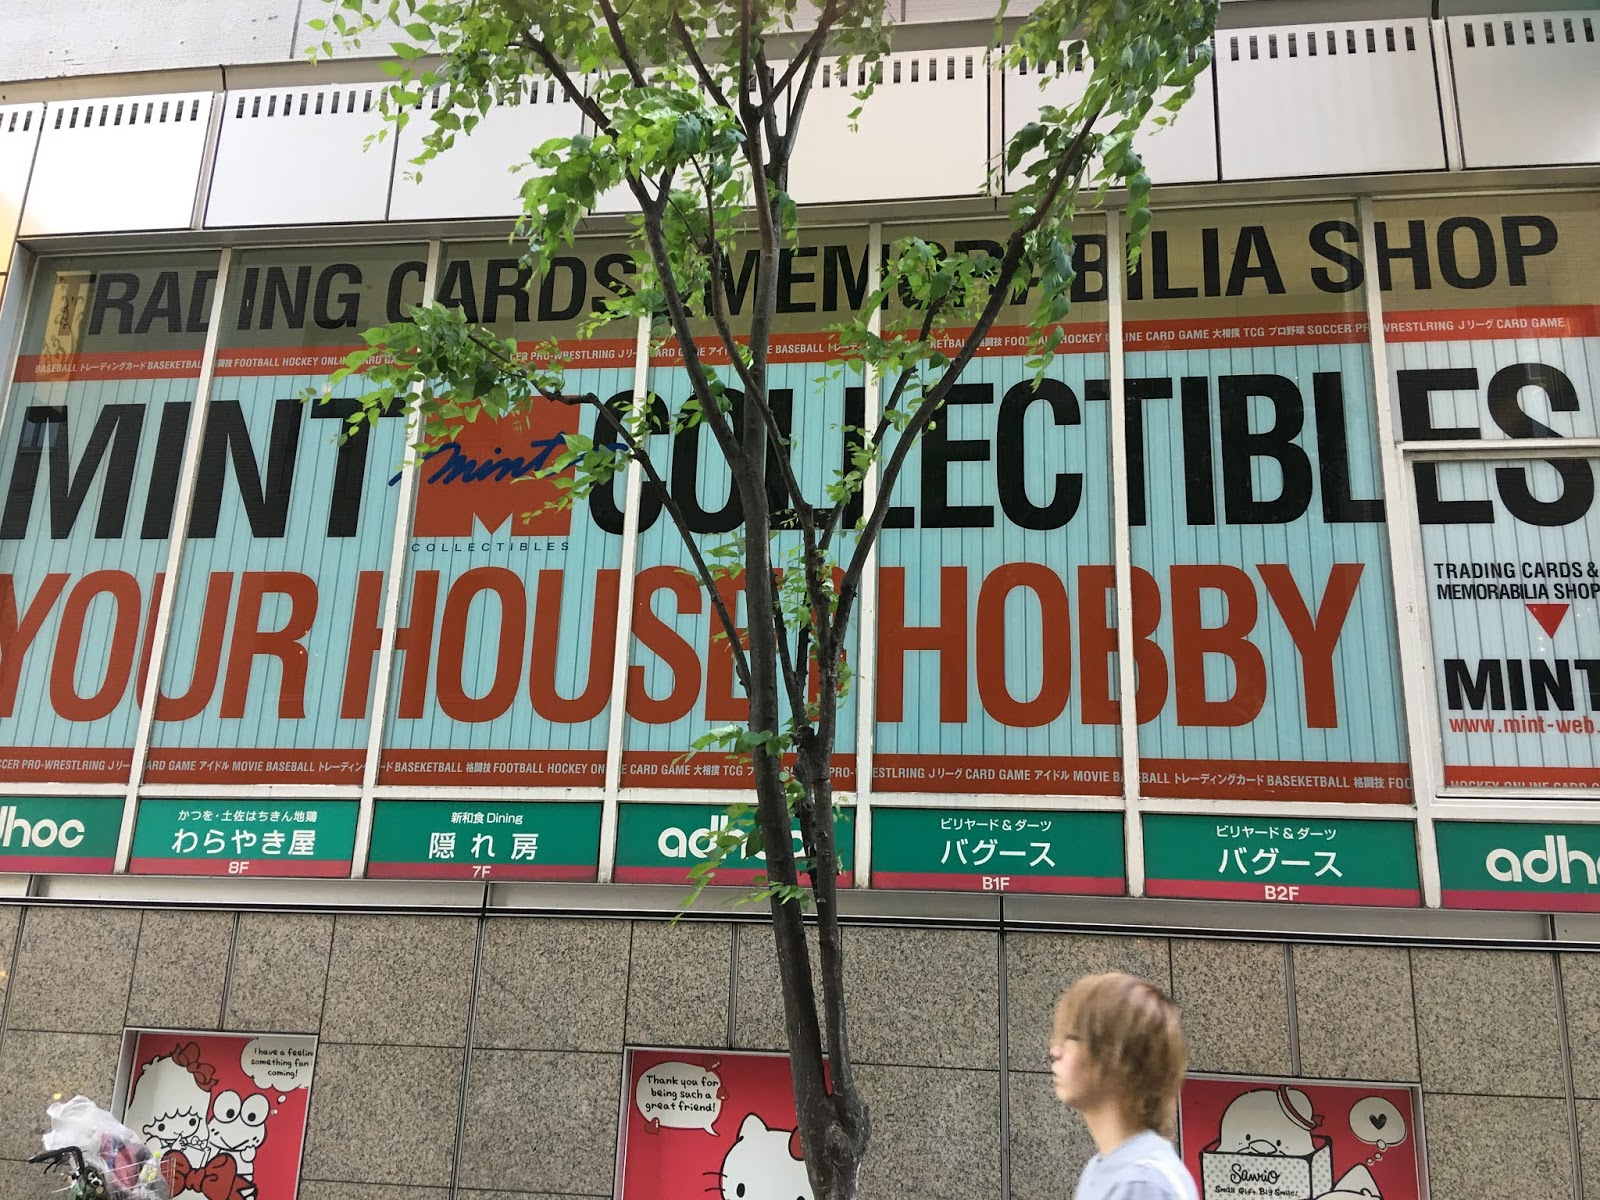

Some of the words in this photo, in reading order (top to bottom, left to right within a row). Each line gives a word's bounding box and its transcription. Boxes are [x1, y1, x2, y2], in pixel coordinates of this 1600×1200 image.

[385, 253, 638, 325] CARDS
[703, 226, 1286, 317] MEMBILIA
[1308, 215, 1558, 294] SHOP
[35, 363, 77, 373] BASEBALL
[147, 360, 203, 370] BASEKETBAL
[213, 358, 233, 368] 闘技
[234, 357, 280, 367] FOOTBALL
[283, 356, 319, 367] HOCKEY
[321, 356, 349, 366] ONLI
[359, 355, 382, 365] ARD
[652, 347, 675, 357] ARD
[775, 343, 824, 353] BASEBALL
[1061, 333, 1102, 344] HOCKEY
[1146, 331, 1175, 342] CARD
[1178, 329, 1209, 340] GAME
[1212, 327, 1240, 338] 大相撲
[1243, 326, 1265, 338] TCG
[1268, 325, 1305, 336] プロ野球
[1307, 323, 1352, 335] SOCCER
[1497, 318, 1528, 329] CARD
[1531, 317, 1565, 328] GAME
[0, 398, 405, 540] MINT
[588, 362, 1595, 535] COLLECTIBLES
[411, 541, 569, 552] COLLECTIBLES
[1434, 562, 1516, 579] TRADING
[1522, 562, 1583, 578] CARDS
[1586, 561, 1599, 578] &
[1437, 583, 1549, 600] MEMORABILIA
[1554, 583, 1600, 600] SHOP
[0, 569, 318, 722] YOUR
[340, 566, 783, 724] HOUSE
[875, 562, 1365, 729] HOBBY
[1444, 659, 1600, 711] MINT
[21, 759, 105, 771] PRO-WRESTLRING
[107, 760, 131, 771] Jリー
[146, 760, 166, 771] ARD
[168, 760, 196, 771] GAME
[199, 761, 229, 771] アイドル
[232, 761, 263, 772] MOVIE
[266, 761, 315, 772] BASEBALL
[394, 761, 463, 773] BASEKETBALL
[466, 761, 491, 773] 格闘技
[493, 762, 544, 774] FOOTBALL
[547, 763, 588, 774] HOCKEY
[630, 764, 658, 775] CARD
[661, 764, 691, 775] GAME
[693, 764, 720, 776] 大相撲
[723, 765, 743, 776] TCG
[965, 768, 996, 780] CARD
[999, 769, 1031, 781] GAME
[1034, 769, 1070, 781] アイドル
[1073, 770, 1110, 782] MOVIE
[1174, 772, 1264, 787] トレーディングカード
[1267, 775, 1351, 788] BASEKETBALL
[1353, 776, 1385, 789] 格闘技
[451, 811, 485, 825] 新和食
[487, 812, 523, 825] Dining
[940, 817, 999, 831] ビリヤード
[1002, 819, 1012, 831] &
[1015, 819, 1052, 832] ダーツ
[658, 815, 806, 859] adh
[1216, 825, 1280, 839] ビリヤード
[1282, 828, 1294, 840] &
[1297, 827, 1337, 840] ダーツ
[171, 828, 316, 856] わらやき屋
[428, 832, 539, 860] 隠れ房
[940, 838, 1056, 867] バグース
[1485, 834, 1600, 885] adh
[228, 861, 249, 875] 8F
[1218, 846, 1343, 878] バグース
[472, 865, 491, 879] 7F
[982, 876, 1011, 891] B1F
[1264, 885, 1299, 901] B2F
[258, 1047, 278, 1056] have
[250, 1058, 292, 1069] something
[294, 1058, 309, 1067] fun
[267, 1069, 299, 1080] coming!
[646, 1075, 678, 1086] Thank
[680, 1078, 699, 1088] you
[701, 1076, 719, 1087] for
[650, 1087, 677, 1101] being
[680, 1088, 703, 1099] such
[645, 1101, 676, 1113] great
[678, 1101, 716, 1113] friend!
[1230, 1163, 1281, 1185] Sanrio
[1258, 1187, 1273, 1196] Big
